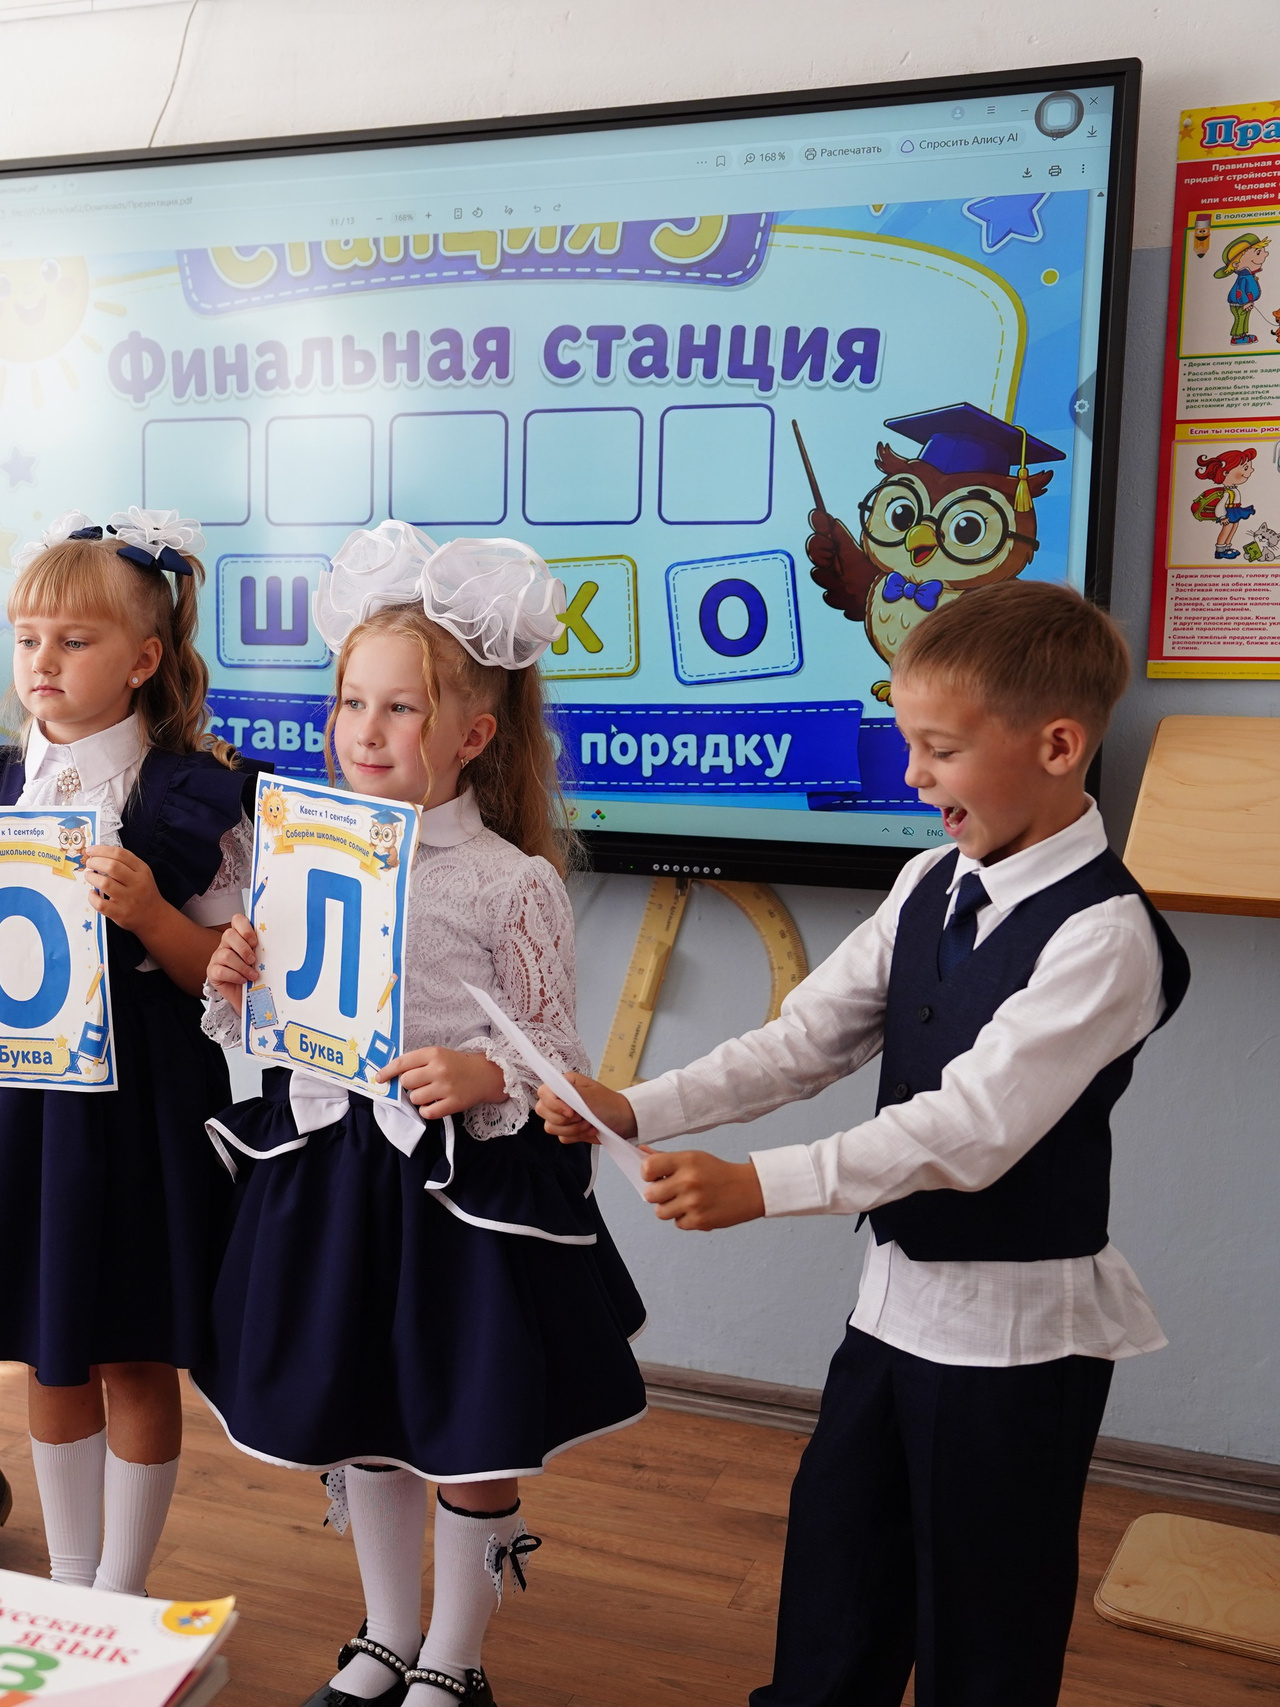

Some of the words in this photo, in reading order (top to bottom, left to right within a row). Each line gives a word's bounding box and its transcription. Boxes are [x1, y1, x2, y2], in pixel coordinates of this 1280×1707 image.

[820, 144, 883, 158] Распечатать
[919, 138, 969, 151] Спросить
[972, 133, 1005, 147] Алису
[1007, 132, 1019, 143] AI
[1212, 160, 1272, 172] Правильная
[1184, 175, 1224, 185] придаёт
[1234, 182, 1277, 191] Человек
[1201, 198, 1219, 206] или
[1222, 191, 1275, 204] «сидячей»
[394, 213, 414, 222] 168%
[1223, 210, 1276, 220] положении
[110, 325, 511, 402] Финальная
[544, 323, 882, 395] станция
[240, 575, 308, 646] Ш
[551, 581, 604, 655] К
[699, 578, 768, 657] О
[580, 731, 793, 778] порядку
[299, 805, 318, 818] Квест
[329, 813, 357, 827] сентября
[7, 827, 11, 836] 1
[13, 827, 45, 838] сентября
[926, 828, 944, 837] ENG
[285, 829, 315, 841] Соберём
[316, 832, 348, 846] школьное
[348, 841, 371, 858] солнце
[0, 849, 36, 857] школьное
[37, 850, 62, 863] солнце
[285, 868, 363, 1019] Л
[299, 1032, 344, 1067] Буква
[15, 1629, 139, 1666] язык
